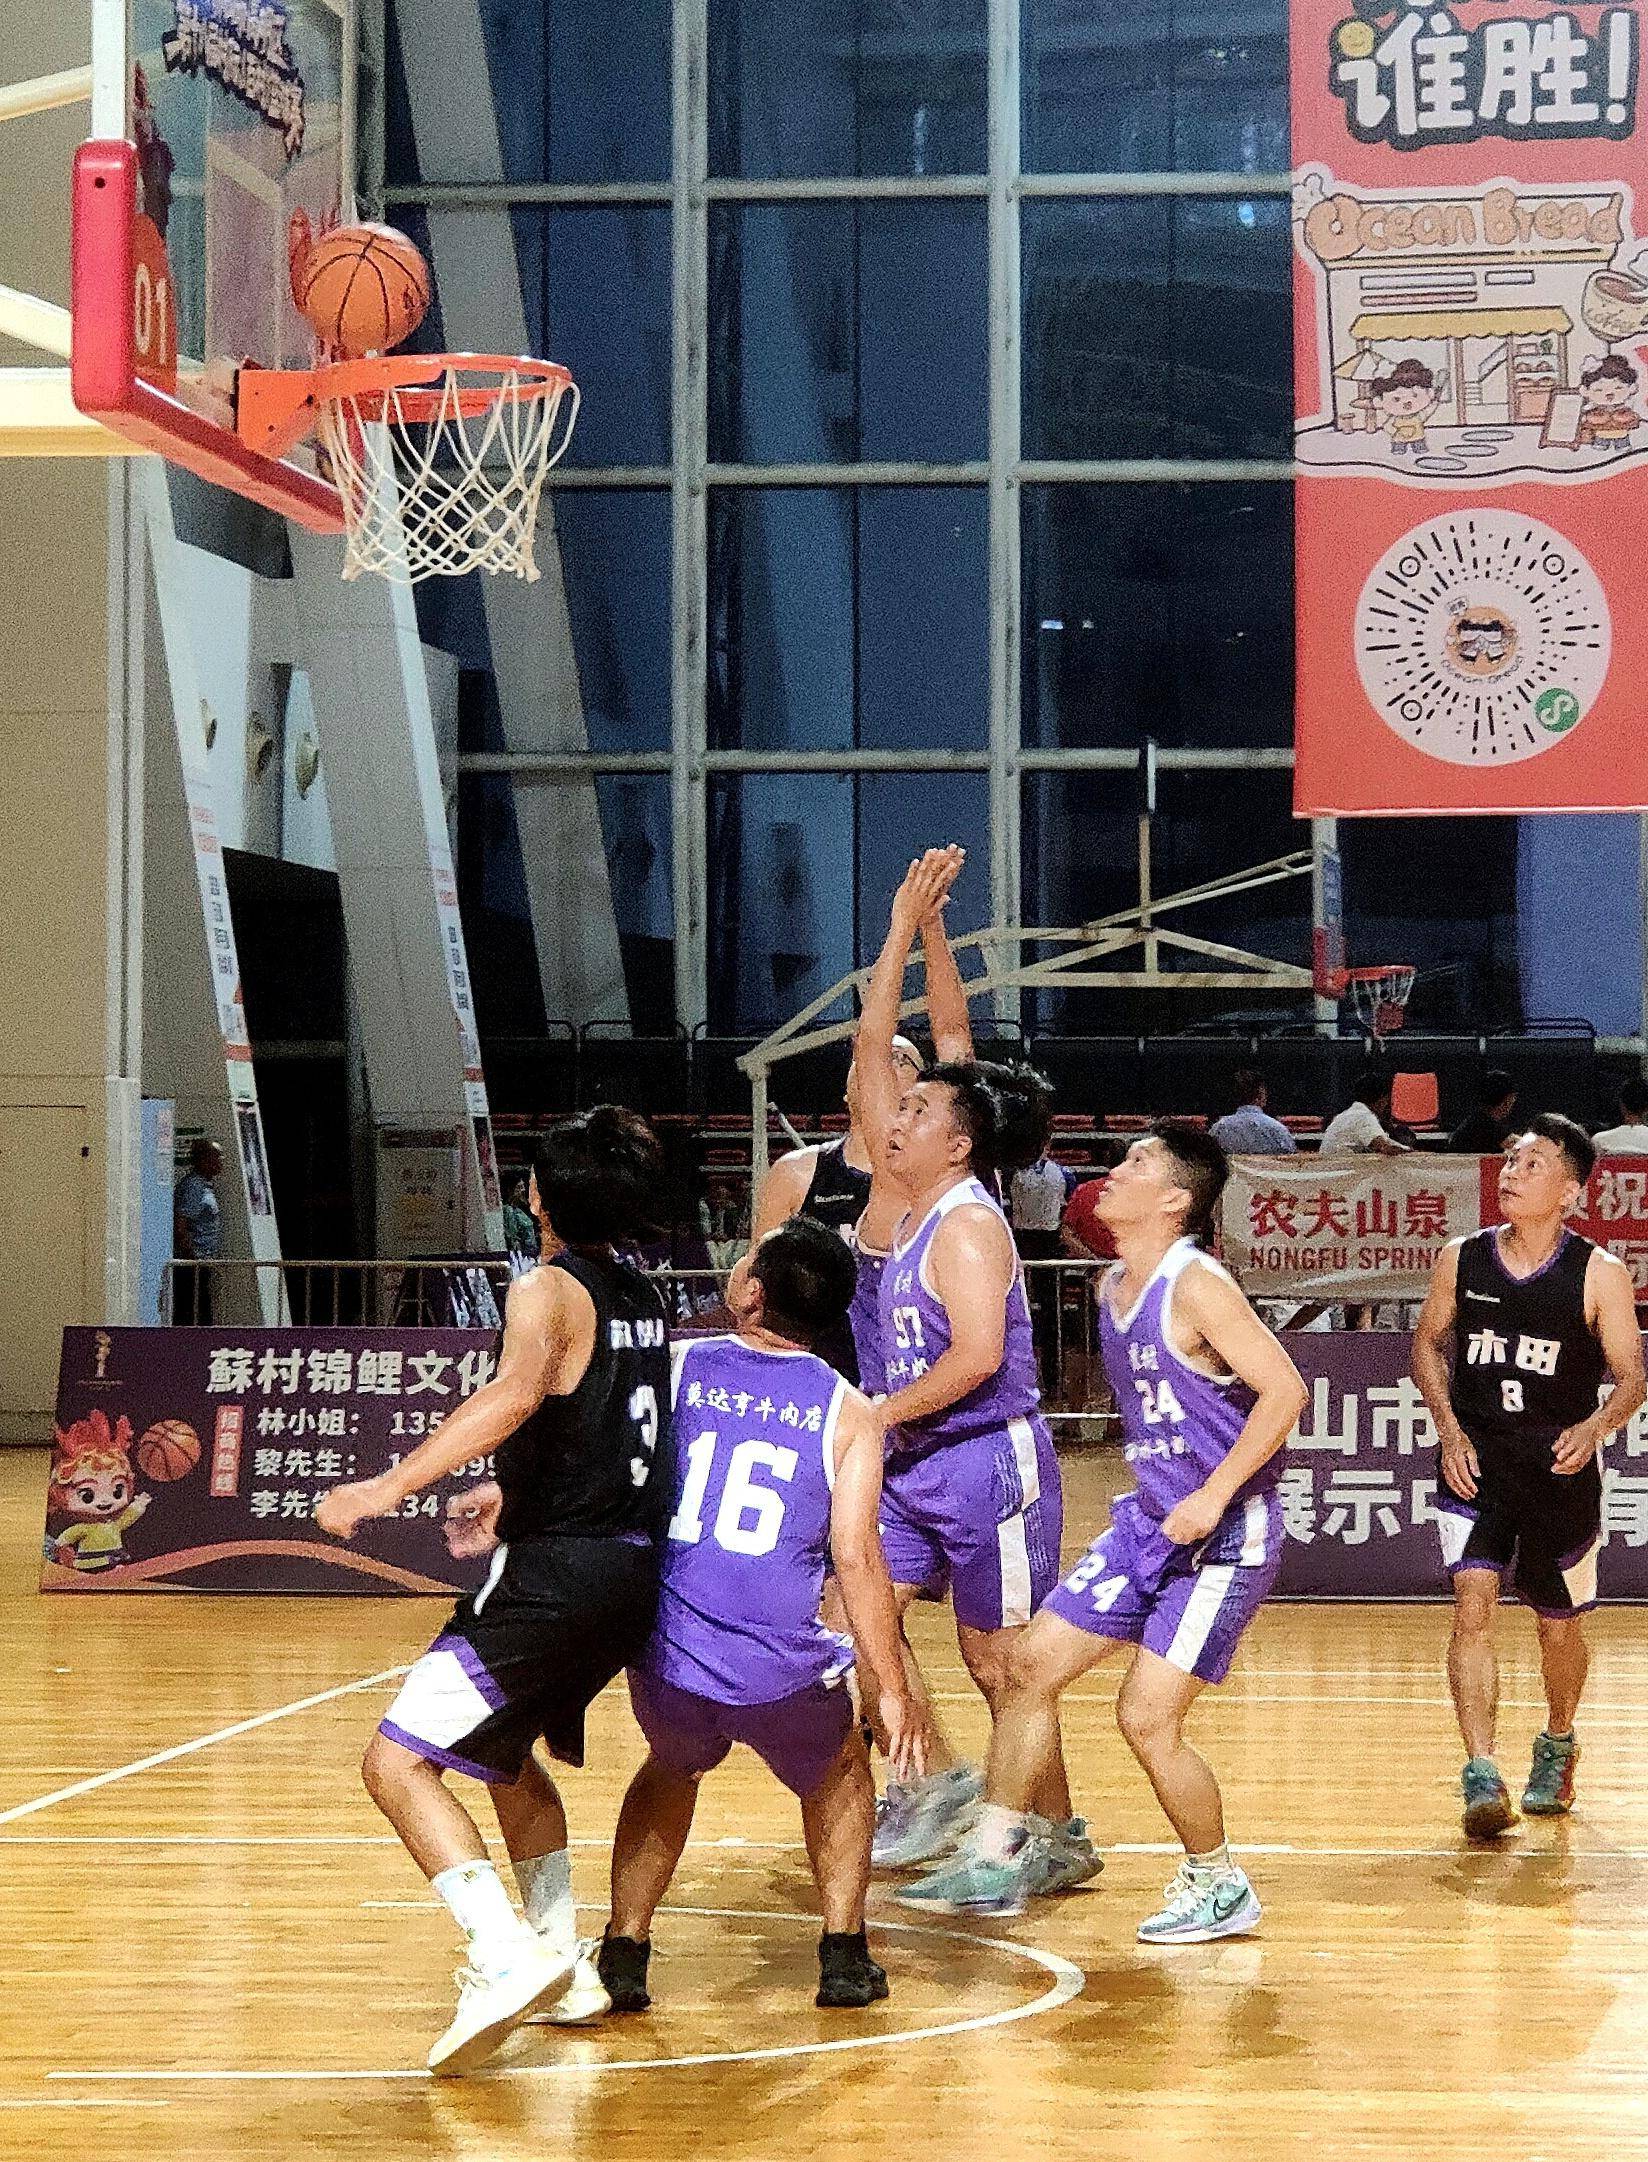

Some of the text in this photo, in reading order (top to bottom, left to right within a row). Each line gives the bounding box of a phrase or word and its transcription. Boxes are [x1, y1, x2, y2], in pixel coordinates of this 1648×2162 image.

[1304, 187, 1624, 260] Ocean Bread
[1249, 1188, 1449, 1240] 农夫山泉
[1249, 1246, 1347, 1270] NONGFU
[1135, 1379, 1187, 1424] 24
[1500, 1380, 1525, 1412] 8
[667, 1431, 799, 1557] 16
[1064, 1552, 1130, 1613] 24
